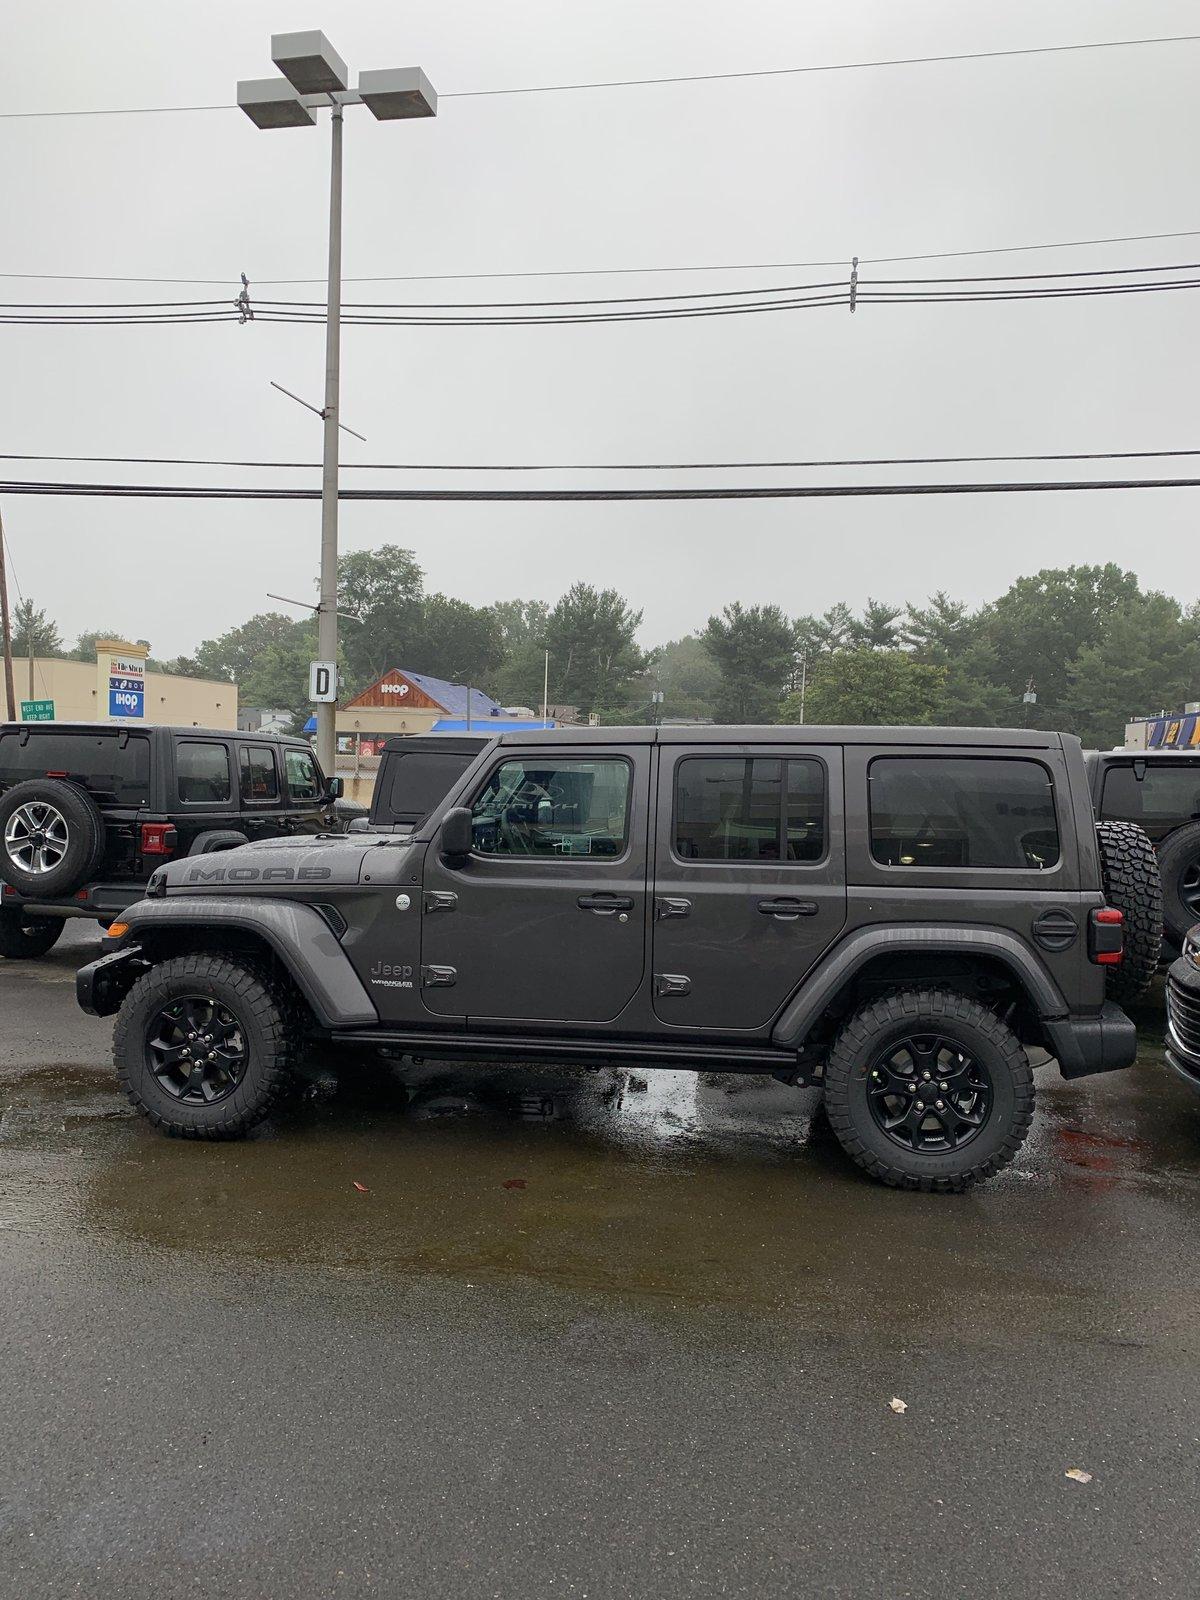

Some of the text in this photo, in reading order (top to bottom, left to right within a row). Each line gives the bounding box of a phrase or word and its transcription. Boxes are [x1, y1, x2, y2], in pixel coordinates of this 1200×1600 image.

[316, 667, 330, 695] D
[189, 867, 332, 881] MOAB
[370, 961, 413, 979] Jeep
